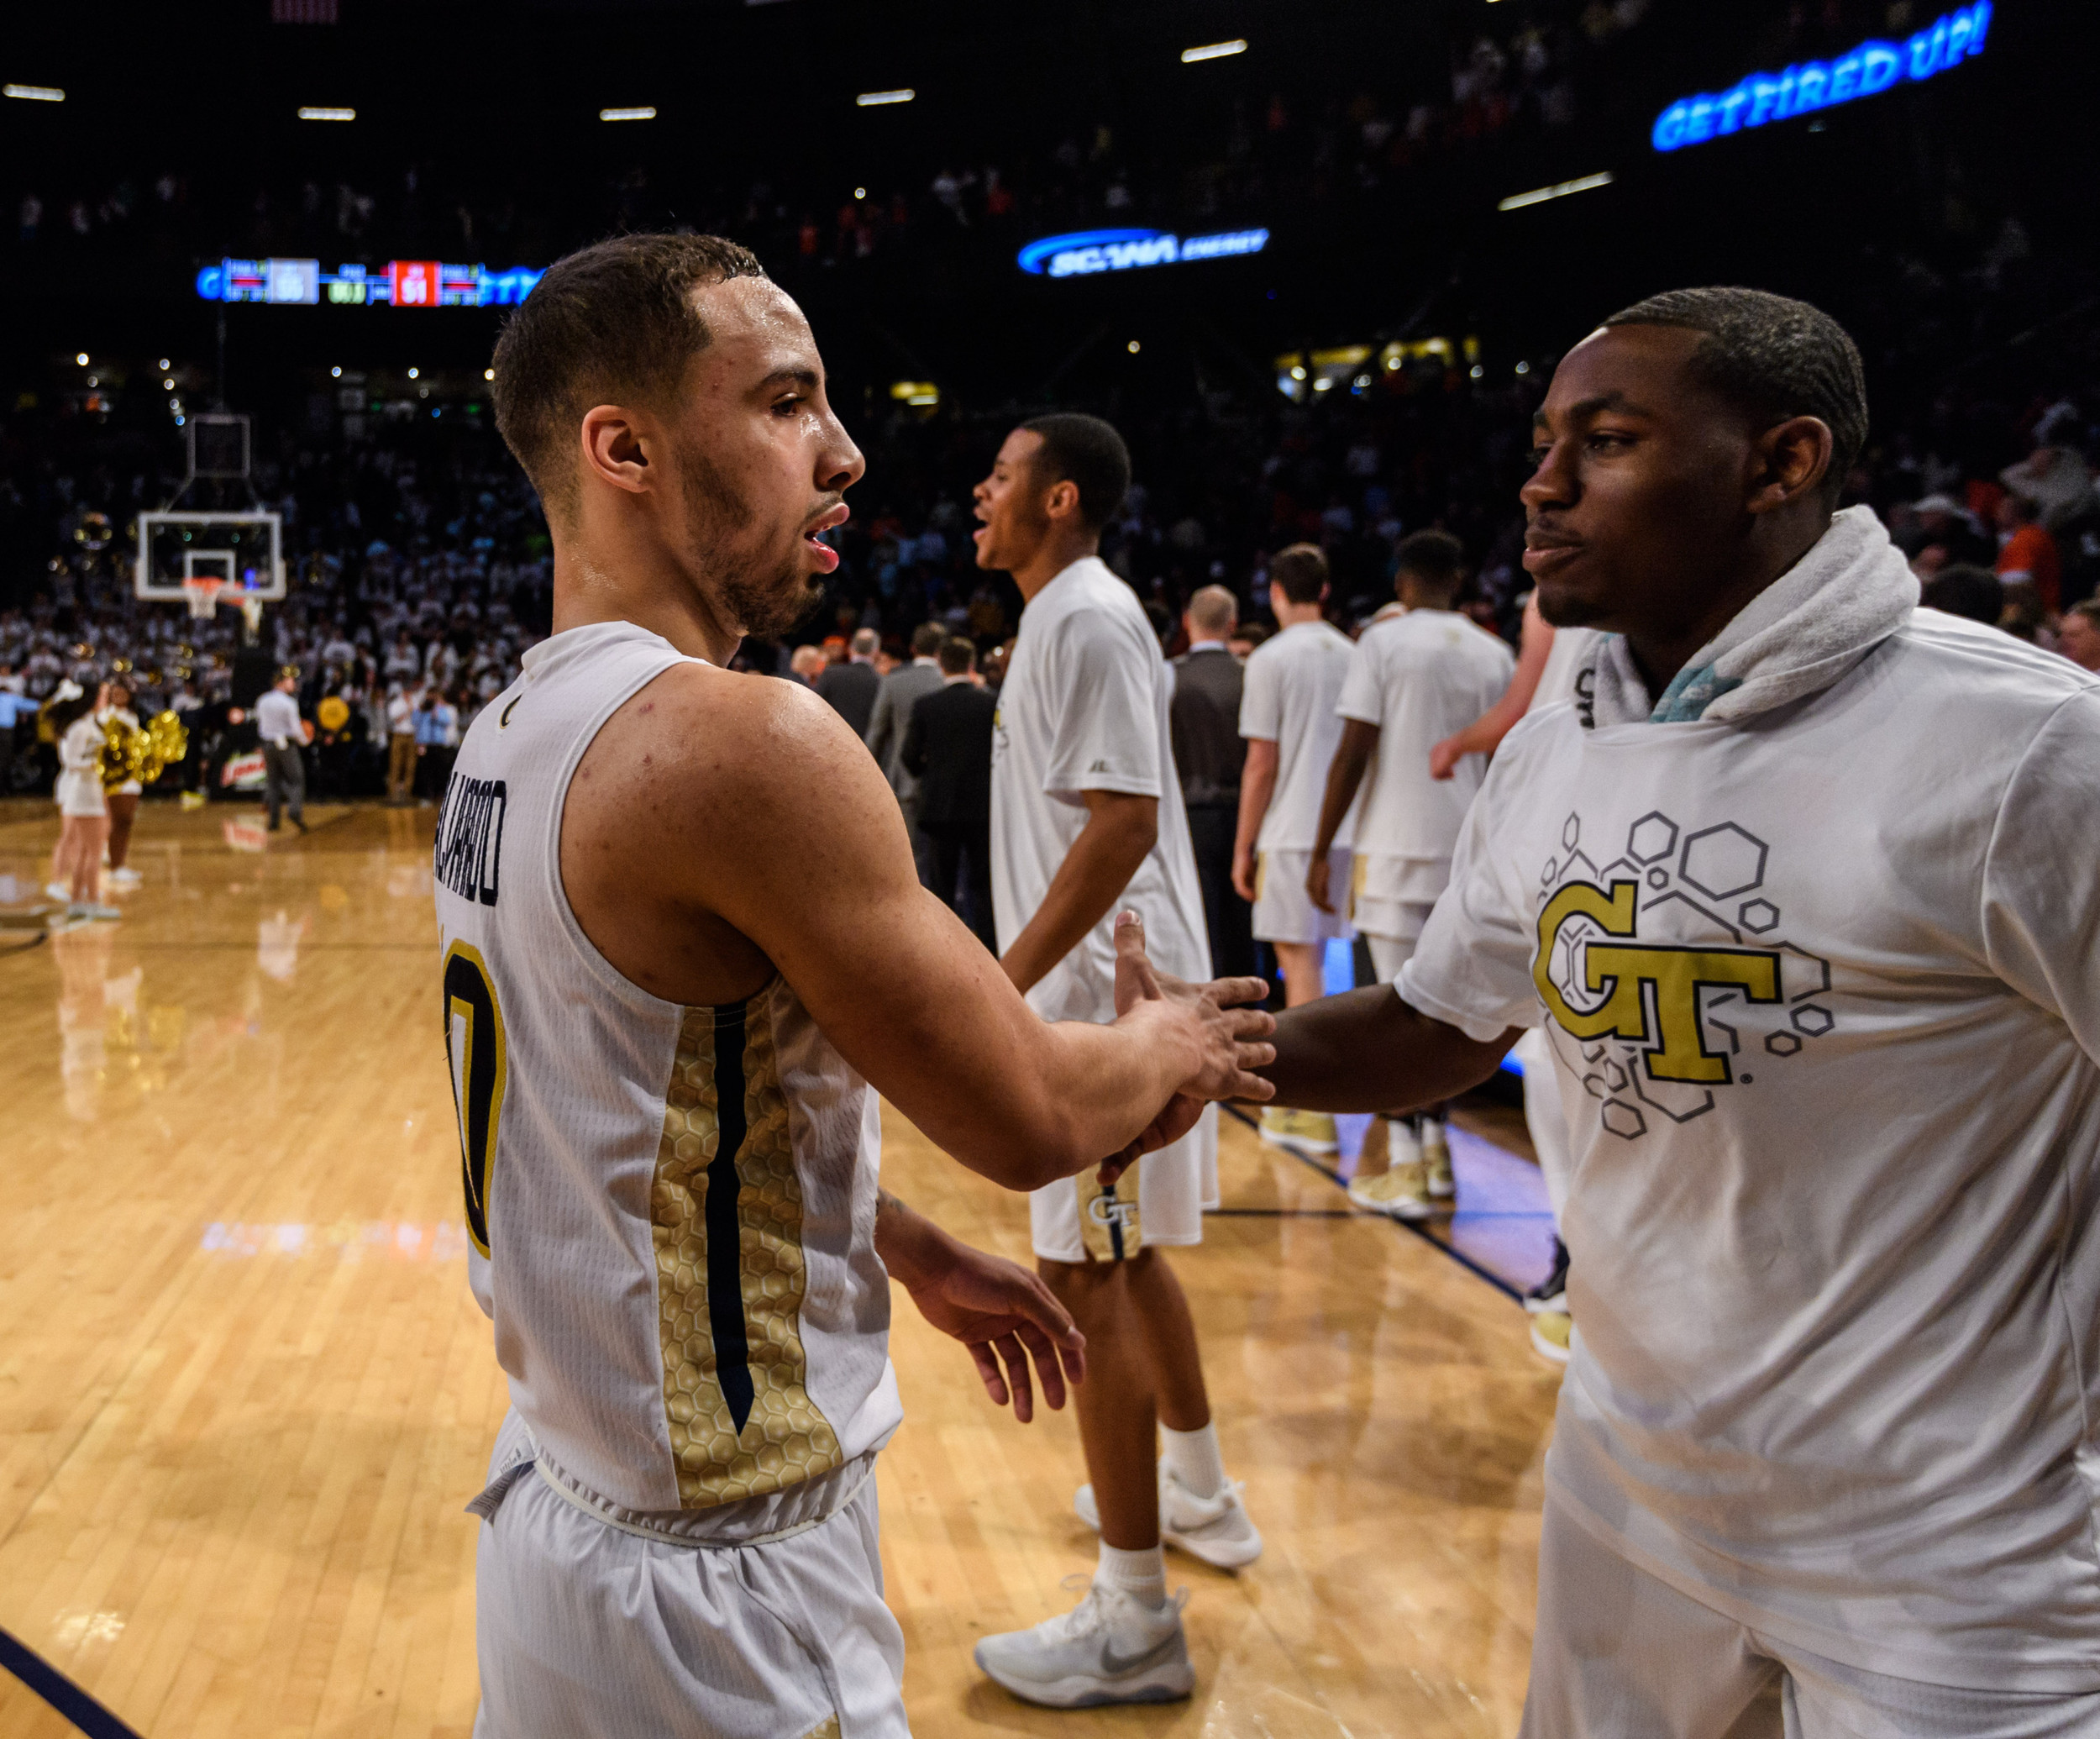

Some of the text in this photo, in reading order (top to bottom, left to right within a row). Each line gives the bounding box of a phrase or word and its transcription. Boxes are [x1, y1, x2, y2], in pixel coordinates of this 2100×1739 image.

[1652, 0, 1992, 151] GET FIRED UP!
[1532, 879, 1783, 1085] GT
[1089, 1194, 1137, 1227] GT
